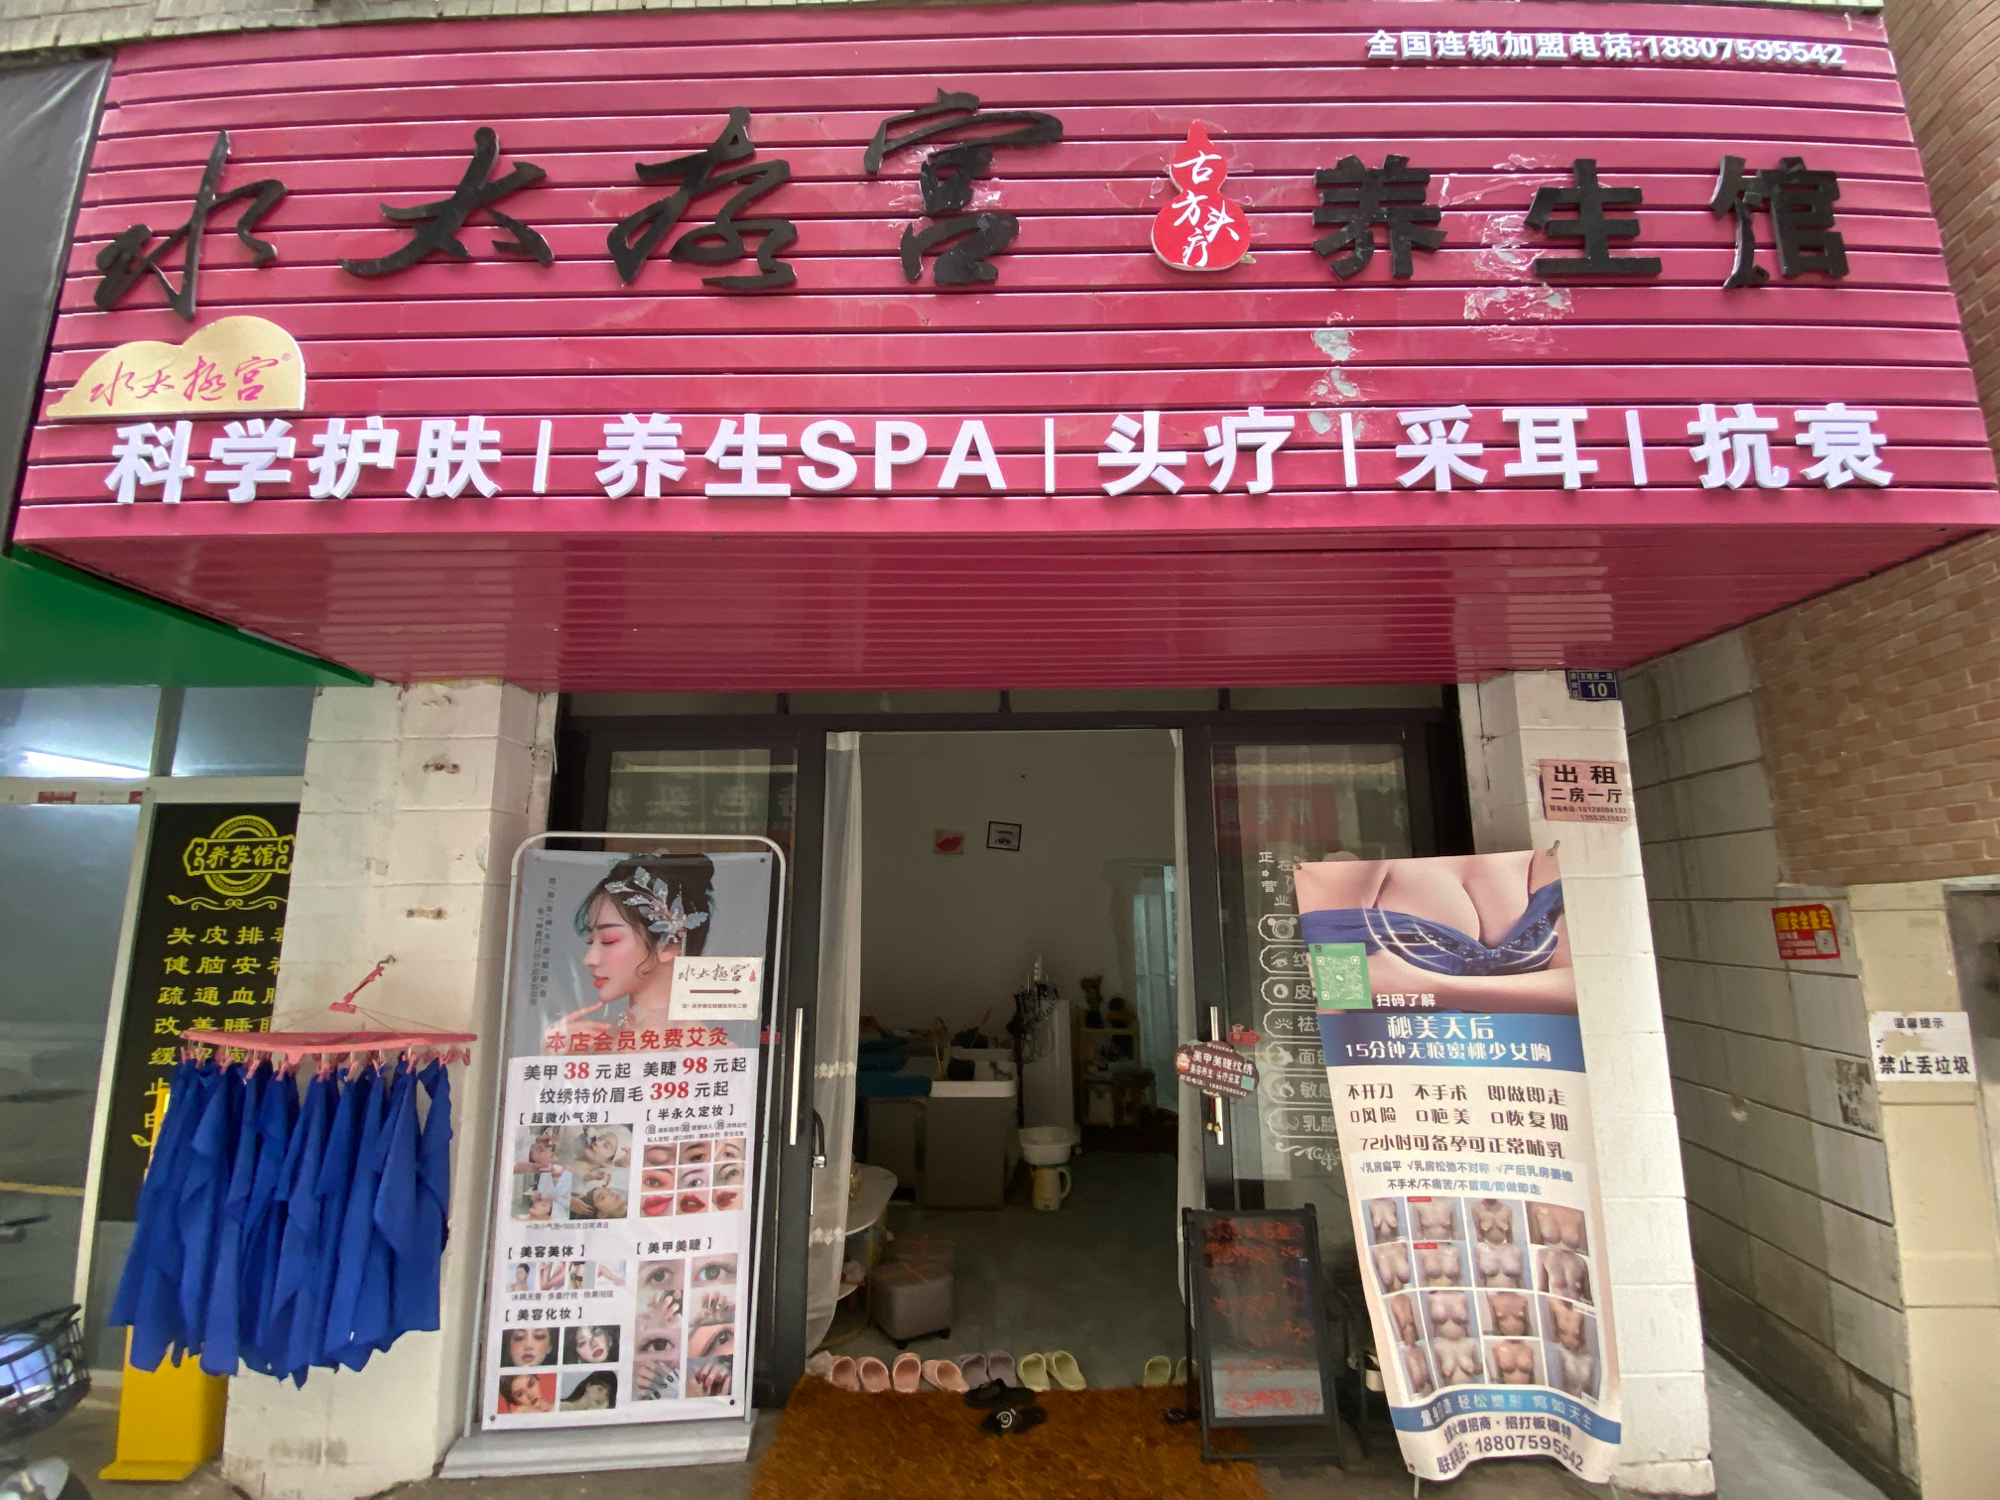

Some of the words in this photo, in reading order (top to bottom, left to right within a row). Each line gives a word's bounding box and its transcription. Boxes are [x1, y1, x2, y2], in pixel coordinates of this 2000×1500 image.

[1311, 154, 1848, 289] 养生馆
[105, 415, 501, 503] 科学护肤
[596, 413, 1007, 498] 养生SPA
[1098, 407, 1294, 496] 头疗
[1396, 404, 1598, 491] 采耳
[1687, 403, 1893, 489] 抗衰
[1588, 683, 1608, 697] 10
[1554, 764, 1617, 784] 出租
[1551, 787, 1622, 803] 二房一厅
[206, 844, 276, 868] 养发馆
[1376, 993, 1436, 1007] 扫码了解
[1387, 1016, 1494, 1040] 秘美天后
[1893, 1017, 1944, 1029] 温馨提示
[546, 1026, 728, 1053] 本店会员免费艾灸
[1878, 1056, 1971, 1075] 禁止丢垃圾
[1347, 1083, 1394, 1100] 不开刀
[1414, 1084, 1467, 1101] 不手术
[1487, 1084, 1567, 1106] 即做即走
